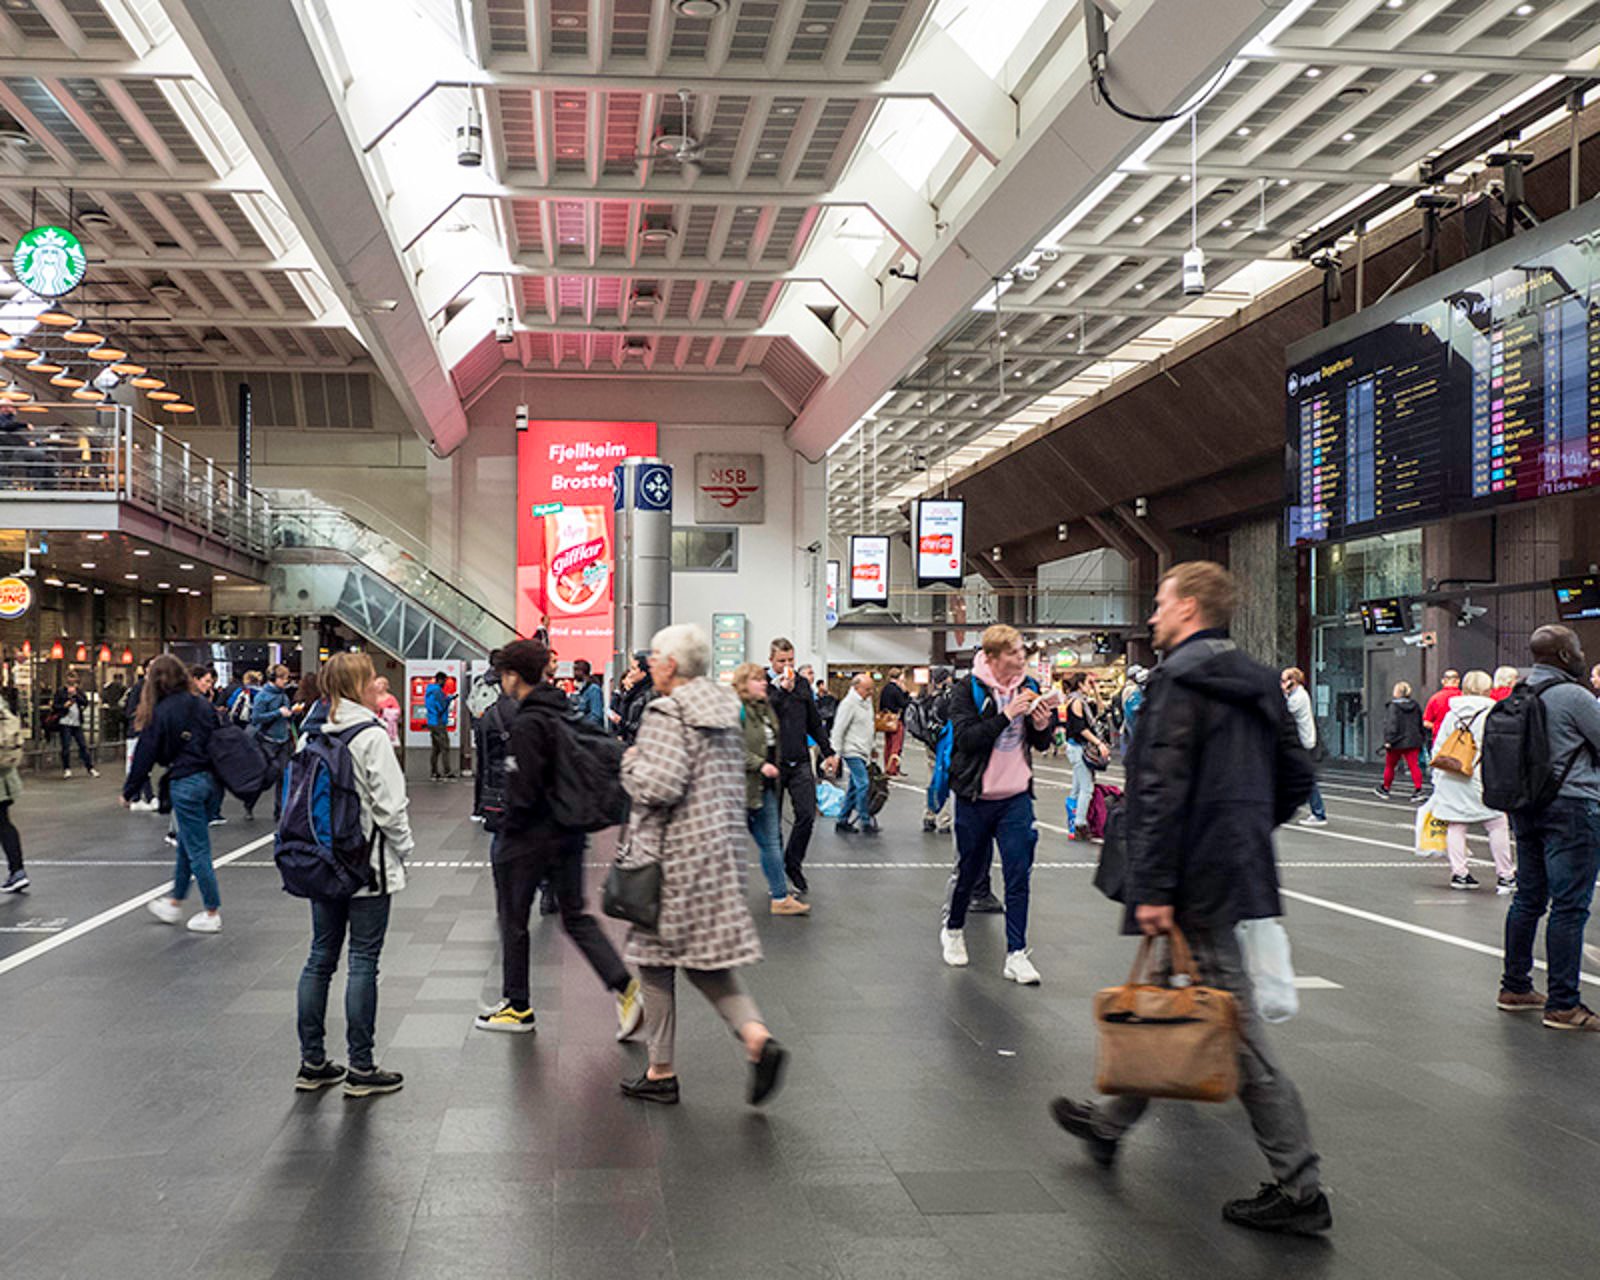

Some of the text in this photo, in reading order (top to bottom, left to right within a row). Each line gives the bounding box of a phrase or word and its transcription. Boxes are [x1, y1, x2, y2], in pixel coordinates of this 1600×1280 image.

[548, 441, 627, 464] Fjellheim
[551, 471, 614, 490] Brostei
[711, 468, 746, 484] NSB
[552, 543, 603, 576] gifflar
